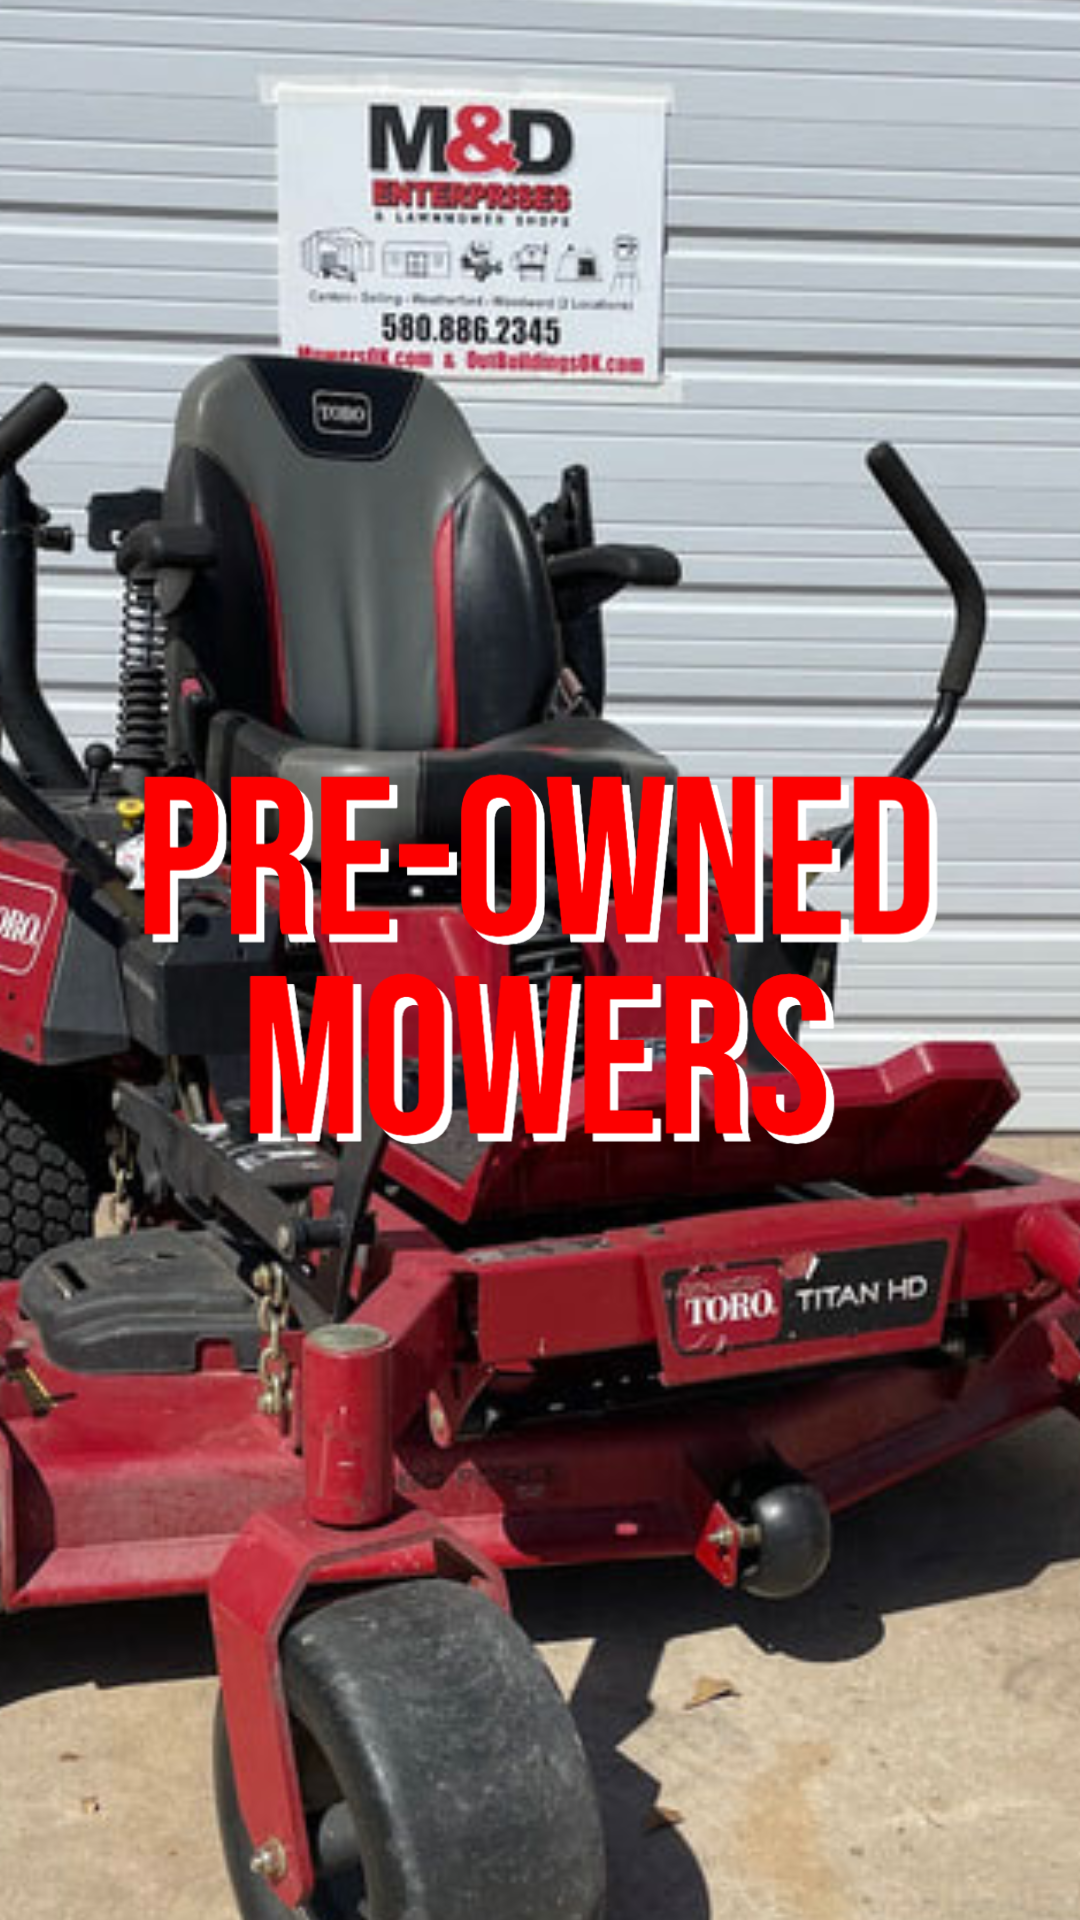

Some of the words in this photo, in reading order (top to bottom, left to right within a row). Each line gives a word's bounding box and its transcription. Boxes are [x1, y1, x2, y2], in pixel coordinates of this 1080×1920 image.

[369, 103, 574, 175] M&D
[372, 179, 571, 213] ENTERPRISES
[516, 215, 570, 228] SHOPS
[381, 312, 561, 346] 580.886.2345
[443, 353, 455, 369] &
[466, 350, 644, 374] OutBuildingsOK.com
[317, 403, 366, 423] TORO
[0, 906, 41, 945] ORO
[685, 1289, 775, 1327] TORO
[796, 1280, 880, 1313] TITAN
[887, 1274, 929, 1302] HD
